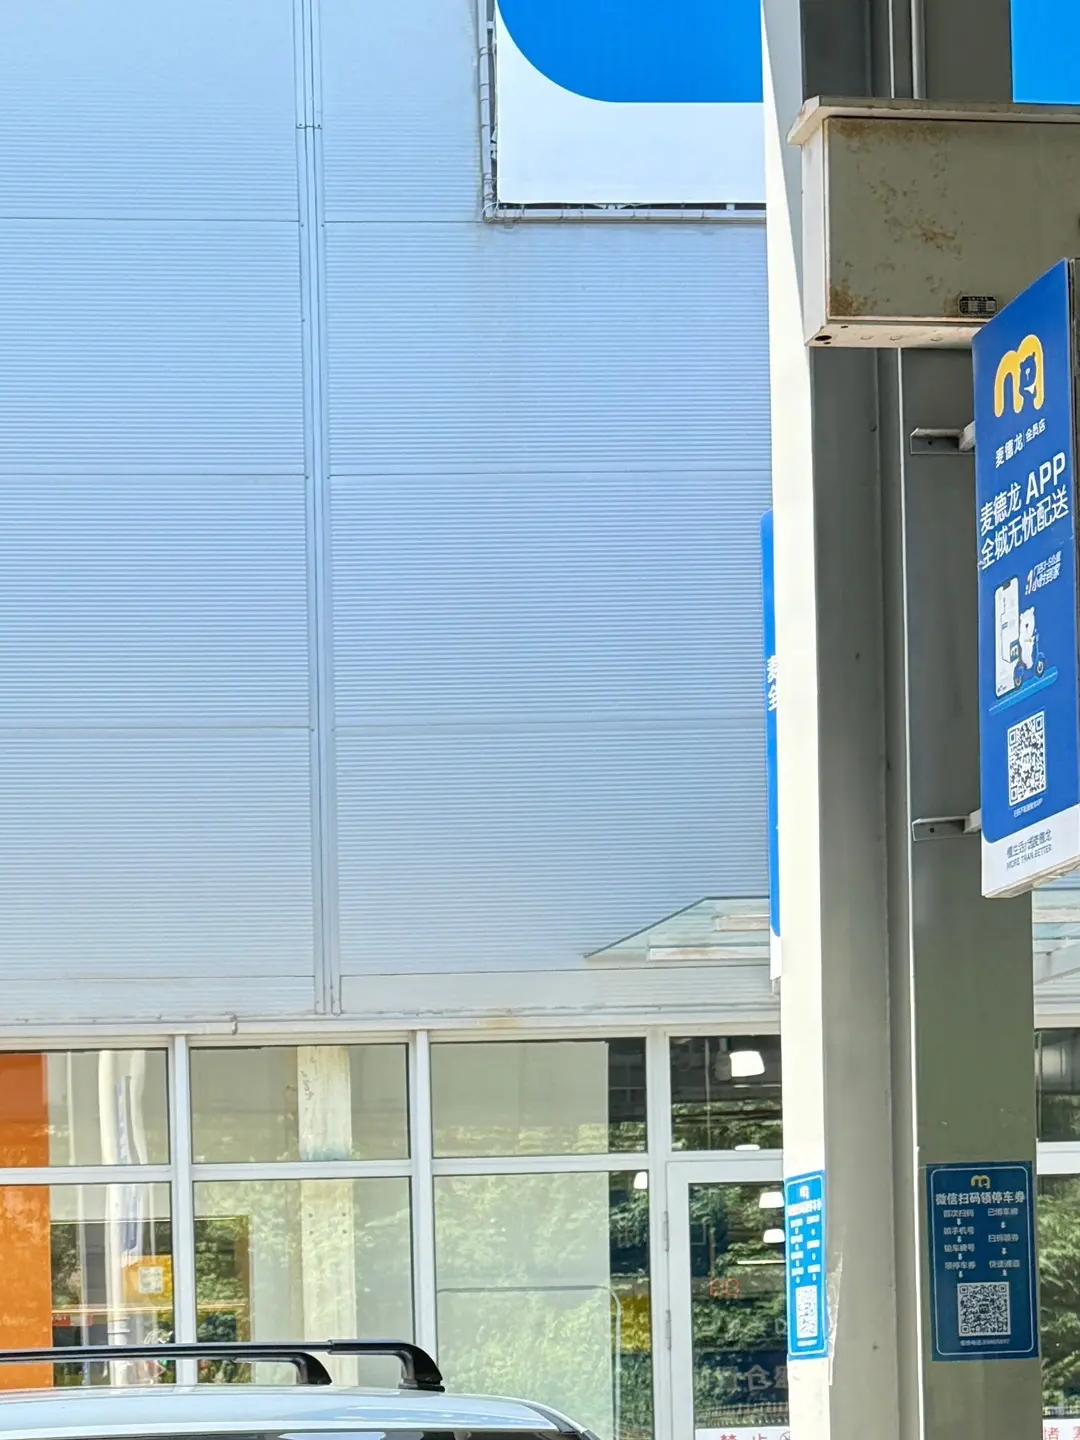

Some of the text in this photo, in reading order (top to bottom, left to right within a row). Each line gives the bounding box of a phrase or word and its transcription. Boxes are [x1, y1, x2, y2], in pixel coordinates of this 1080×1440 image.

[980, 452, 1066, 537] 麦德龙 APP
[981, 484, 1069, 570] 全城无忧配送
[936, 1191, 1025, 1206] 微信扫码领停车券
